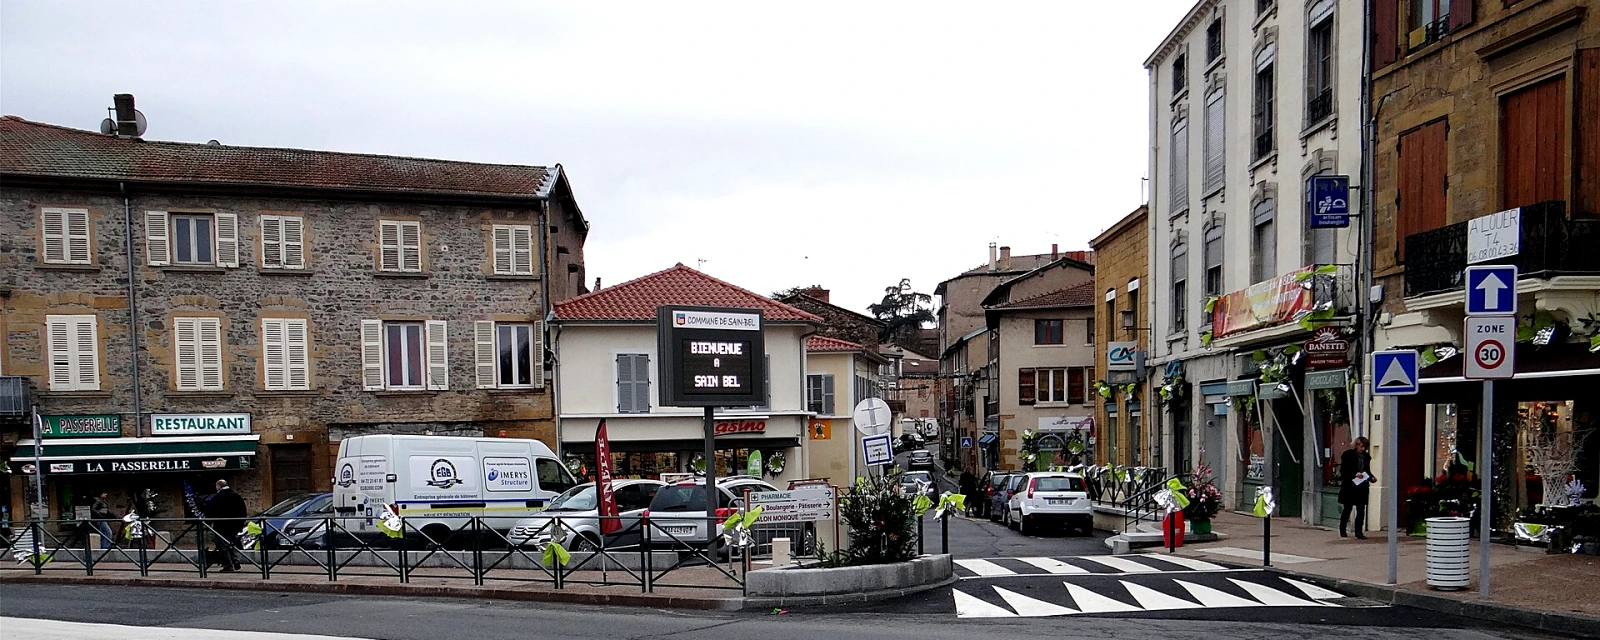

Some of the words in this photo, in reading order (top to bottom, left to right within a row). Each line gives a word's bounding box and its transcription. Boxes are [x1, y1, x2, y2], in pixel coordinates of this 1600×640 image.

[1469, 219, 1479, 235] A
[1481, 210, 1518, 233] LOUER
[687, 315, 718, 325] COMMUNE
[719, 317, 728, 326] DE
[728, 317, 756, 327] SAIN-BEL
[1477, 324, 1505, 333] ZONE
[690, 341, 743, 355] BIENVENUE
[1308, 342, 1346, 351] BANETTE
[1480, 348, 1500, 361] 30
[713, 357, 720, 368] A
[694, 375, 719, 387] SAIN
[722, 375, 741, 388] BEL
[60, 418, 119, 434] PASSERELLE
[155, 418, 245, 430] RESTAURANT
[715, 420, 766, 433] asino
[86, 462, 104, 472] LA
[111, 460, 190, 471] PASSERELLE
[436, 466, 452, 478] EGB
[500, 471, 528, 479] IMERYS
[766, 504, 795, 512] Boulangerie
[773, 514, 799, 522] MONIQUE
